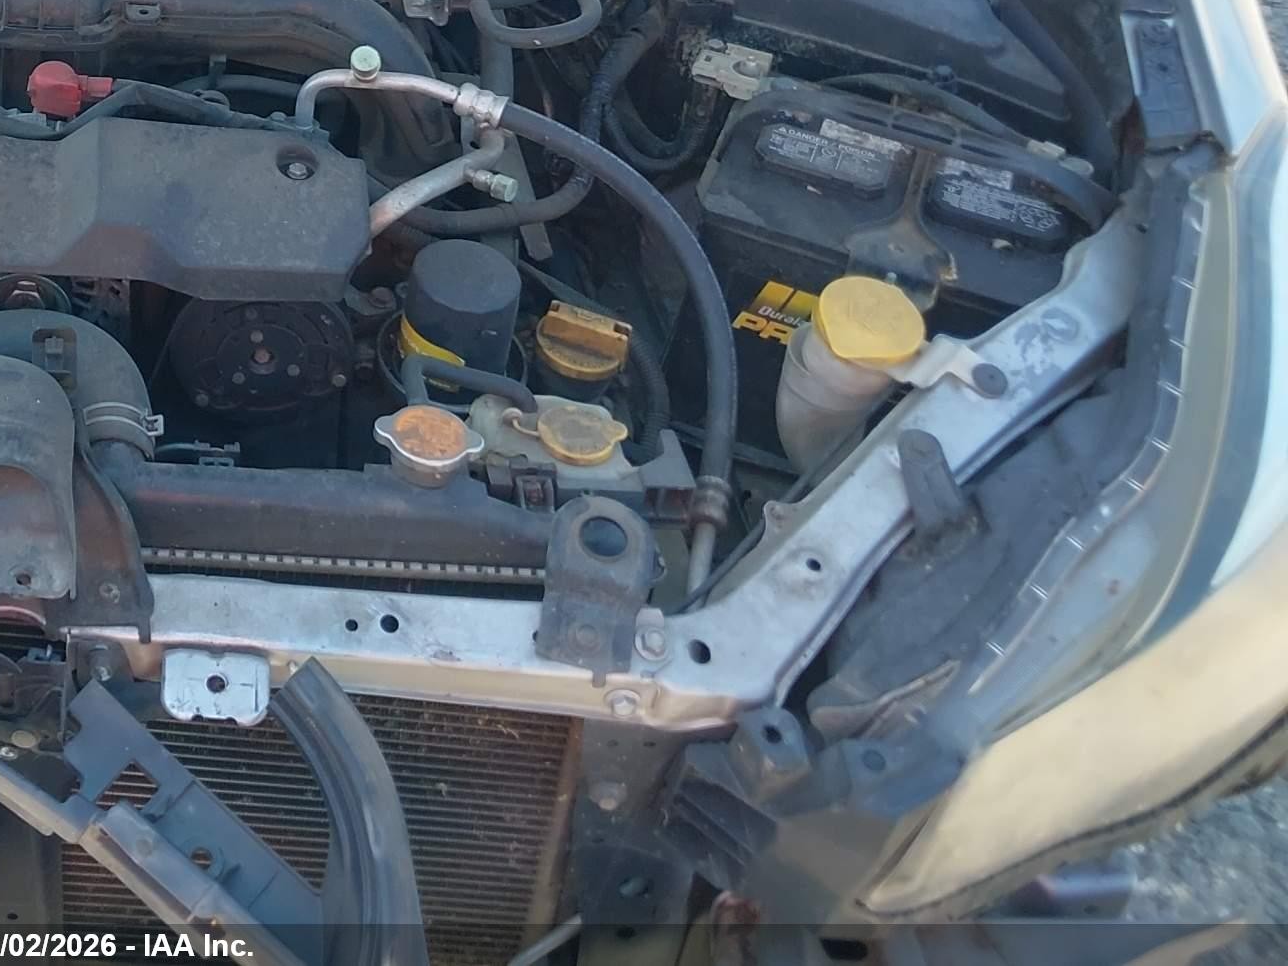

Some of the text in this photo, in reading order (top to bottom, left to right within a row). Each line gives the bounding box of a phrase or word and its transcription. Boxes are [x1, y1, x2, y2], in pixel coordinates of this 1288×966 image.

[788, 129, 829, 146] DANGER
[838, 144, 876, 159] POISON
[758, 305, 801, 327] Dural
